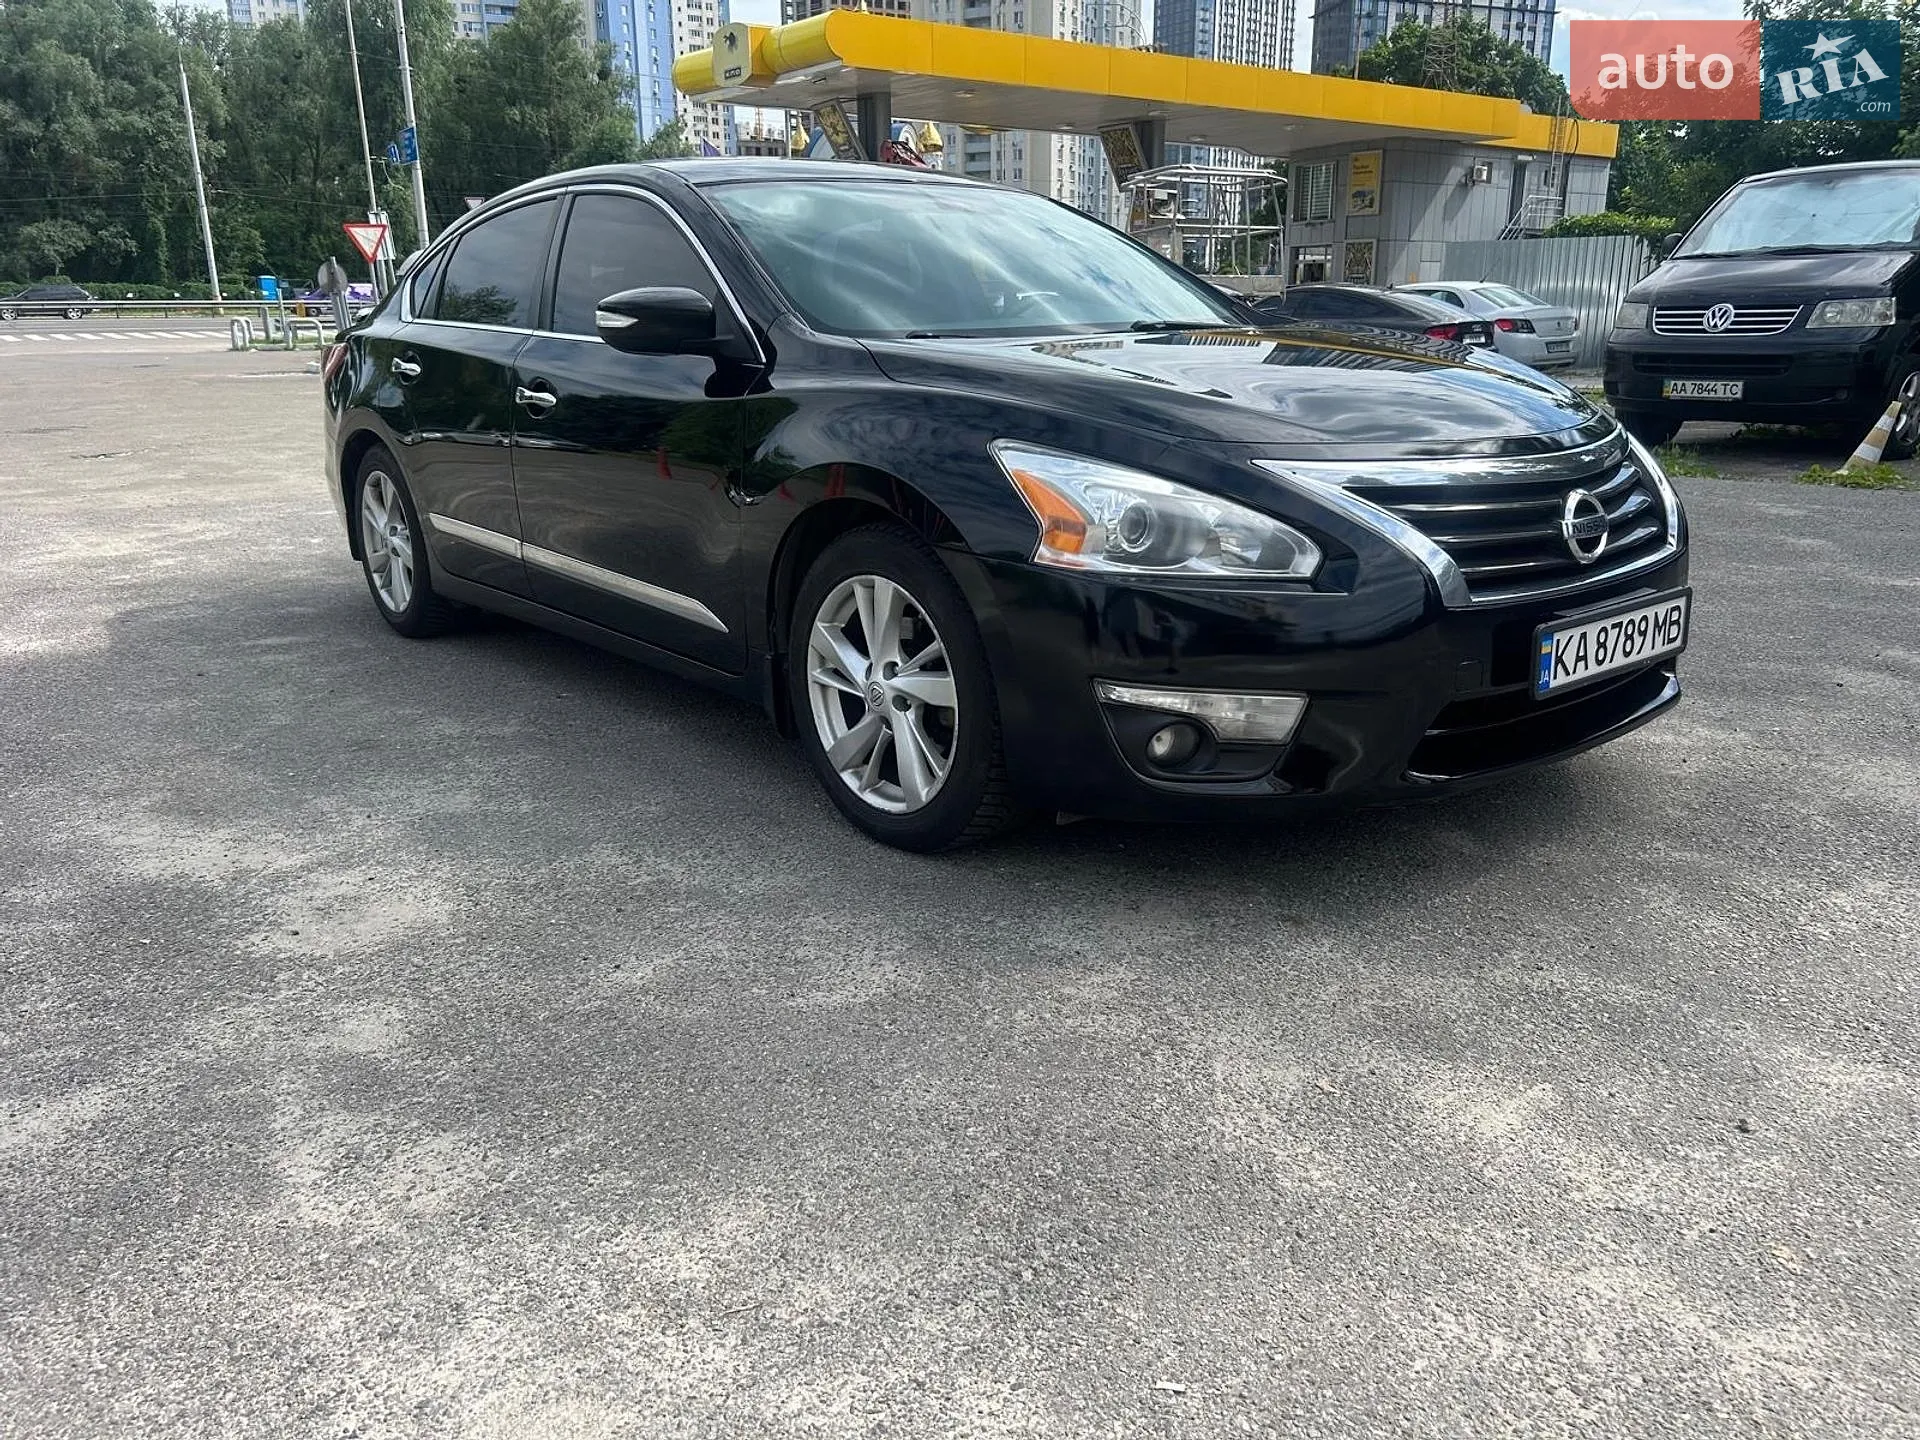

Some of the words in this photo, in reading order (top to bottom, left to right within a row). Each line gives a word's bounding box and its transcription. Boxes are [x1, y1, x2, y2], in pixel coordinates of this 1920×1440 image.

[1670, 382, 1687, 395] AA
[1690, 382, 1718, 396] 7844
[1720, 383, 1739, 396] TC
[1553, 632, 1589, 680] KA
[1594, 614, 1649, 667] 8789
[1651, 604, 1682, 651] MB
